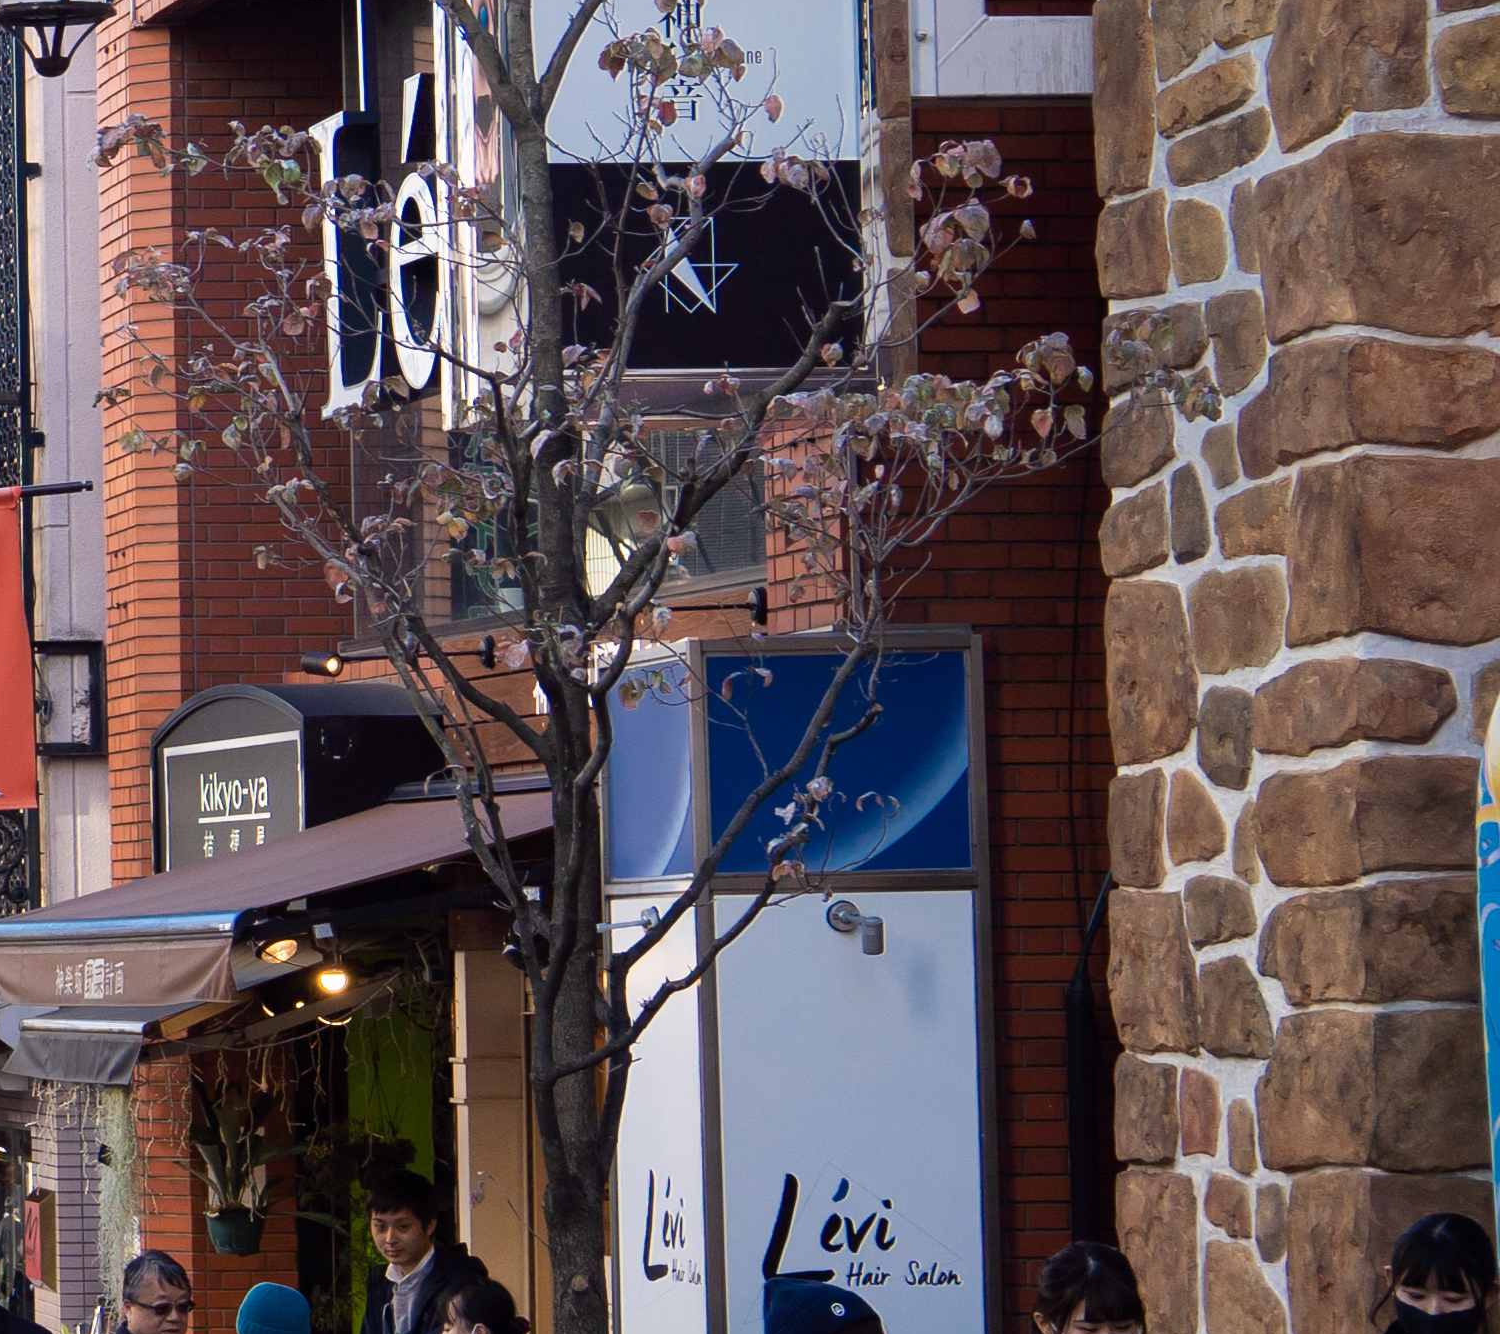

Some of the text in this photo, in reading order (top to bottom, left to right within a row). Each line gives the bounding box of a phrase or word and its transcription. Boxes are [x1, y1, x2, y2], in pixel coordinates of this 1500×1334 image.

[200, 772, 269, 816] kikyo-ya
[762, 1172, 897, 1281] Lévi
[847, 1260, 963, 1288] Hair Salon
